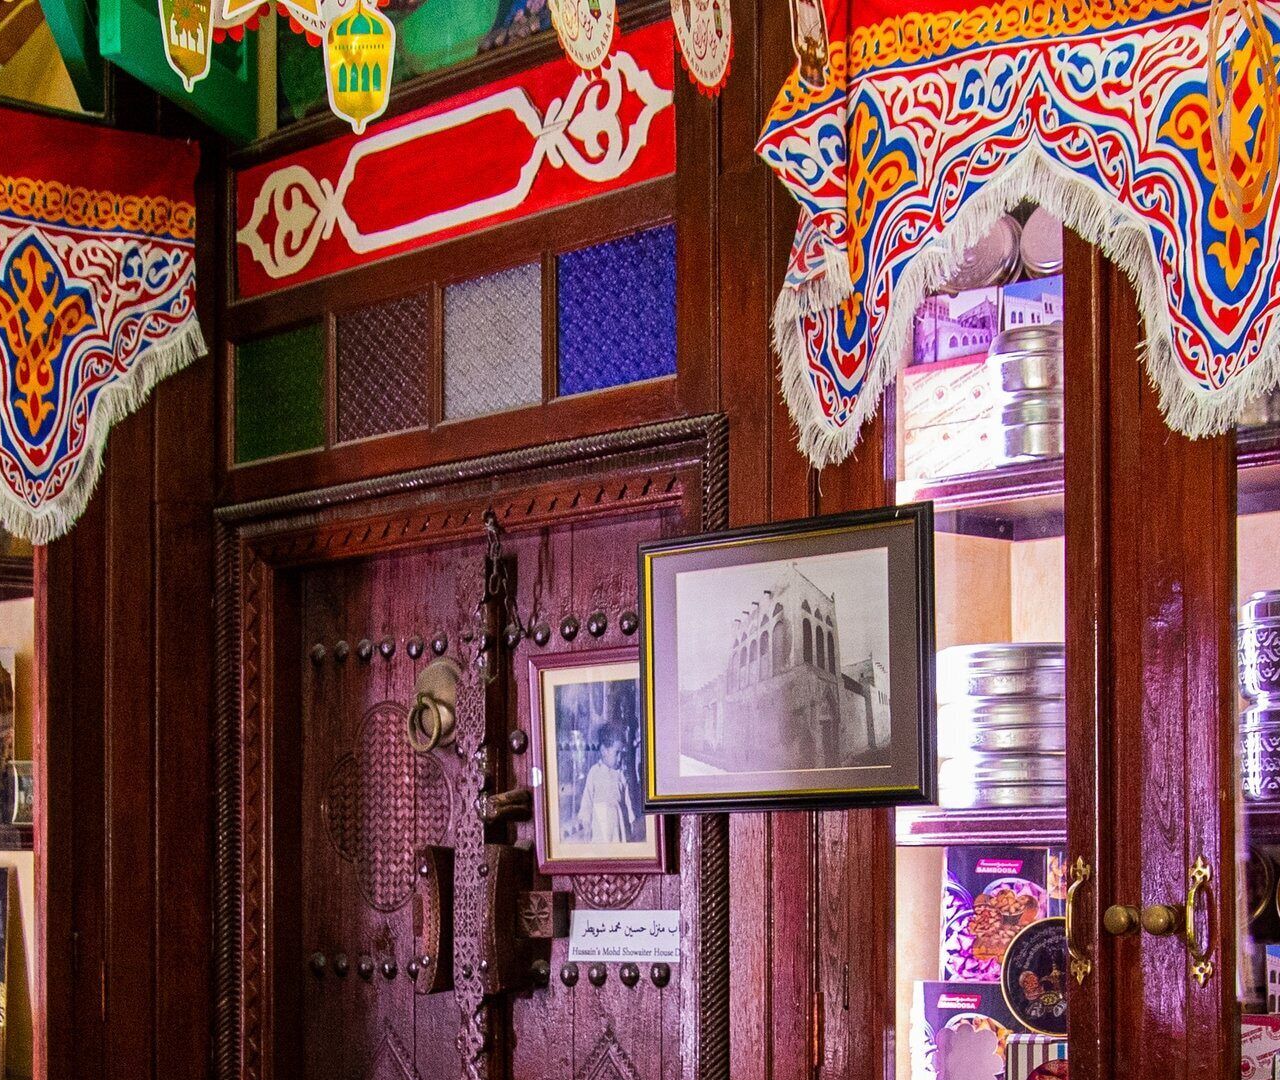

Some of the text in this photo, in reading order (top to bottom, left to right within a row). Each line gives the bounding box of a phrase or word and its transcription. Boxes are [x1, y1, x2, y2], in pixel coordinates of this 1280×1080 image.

[609, 921, 622, 933] محمد
[624, 925, 646, 937] حسين
[649, 920, 665, 937] منزل
[572, 946, 601, 956] Hussain's
[602, 947, 620, 956] Mohd
[653, 948, 673, 956] House
